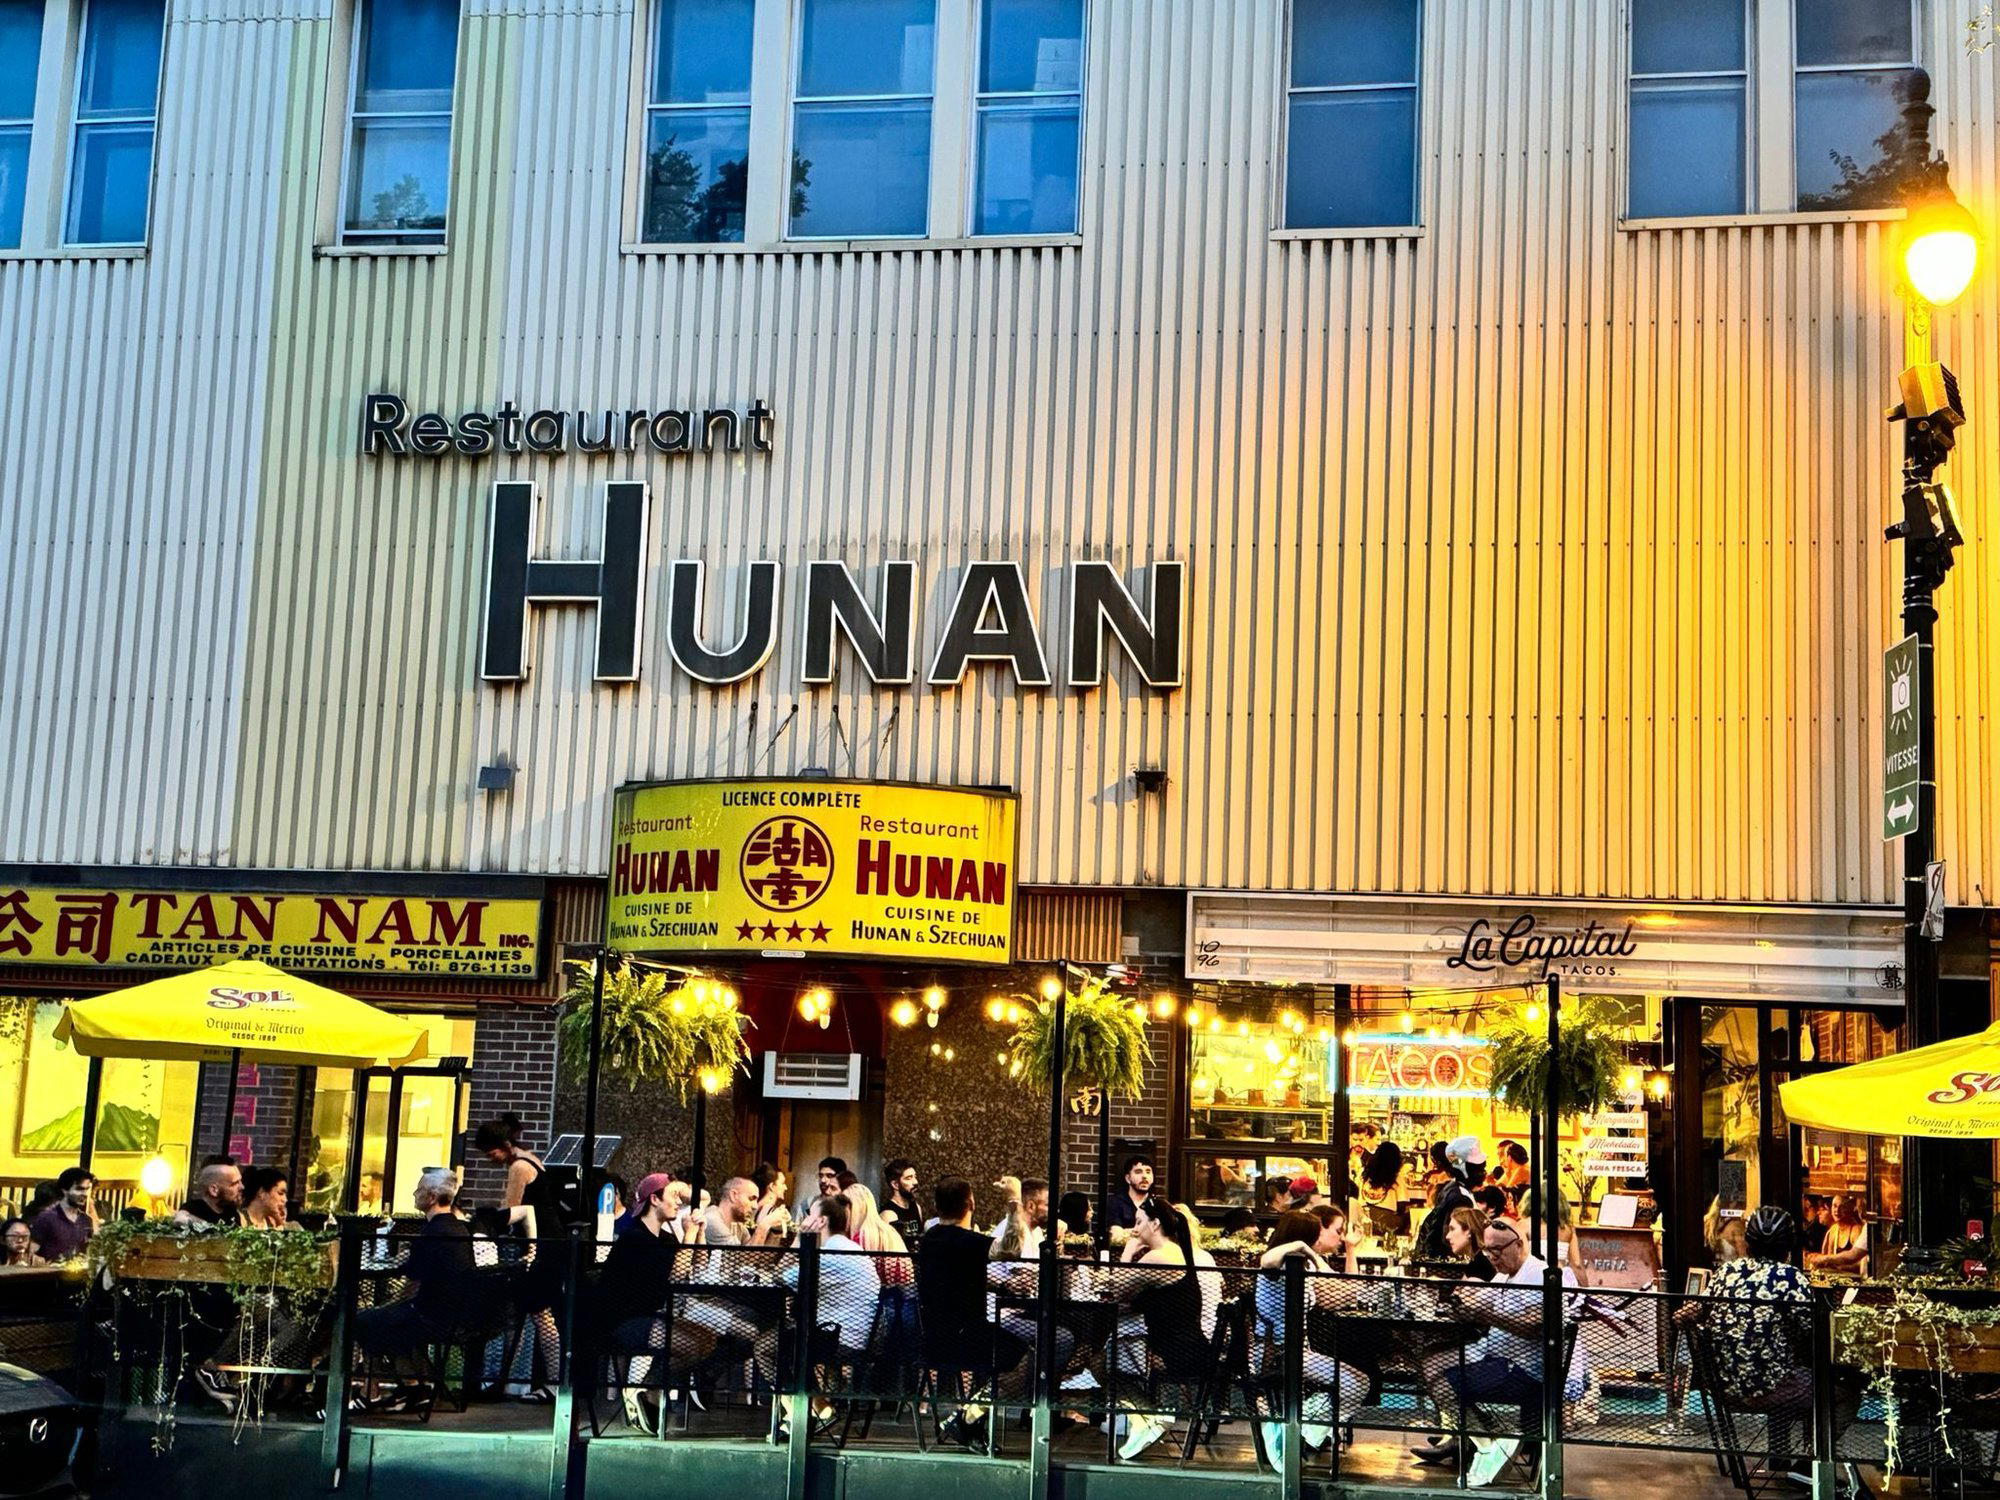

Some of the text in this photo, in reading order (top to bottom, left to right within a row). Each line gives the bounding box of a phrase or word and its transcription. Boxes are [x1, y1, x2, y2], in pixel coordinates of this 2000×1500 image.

[362, 393, 775, 455] Restaurant
[481, 480, 1185, 687] HUNAN
[1886, 745, 1918, 775] VITESSE
[722, 791, 776, 806] LICENCE
[618, 814, 693, 837] Restaurant
[860, 815, 979, 840] Restaurant
[614, 843, 720, 897] HUNAN
[856, 839, 1007, 905] HUNAN
[129, 893, 535, 948] TAN NAM INC.
[625, 902, 693, 917] CUISINE DE
[885, 906, 981, 925] CUISINE DE
[610, 918, 719, 939] HUNAN & SZECHUAN
[851, 920, 1006, 949] HUNAN & SZECHUAN
[150, 942, 522, 960] ARTICLES DE CUISINE PORCELAINES
[1198, 940, 1220, 953] 10
[1447, 913, 1637, 979] La Capital
[125, 952, 214, 966] CADEAUX
[449, 960, 532, 974] 876-1139
[1197, 953, 1220, 966] 96
[206, 1017, 252, 1031] Original
[254, 1023, 265, 1032] de
[1349, 1046, 1493, 1091] TACOS
